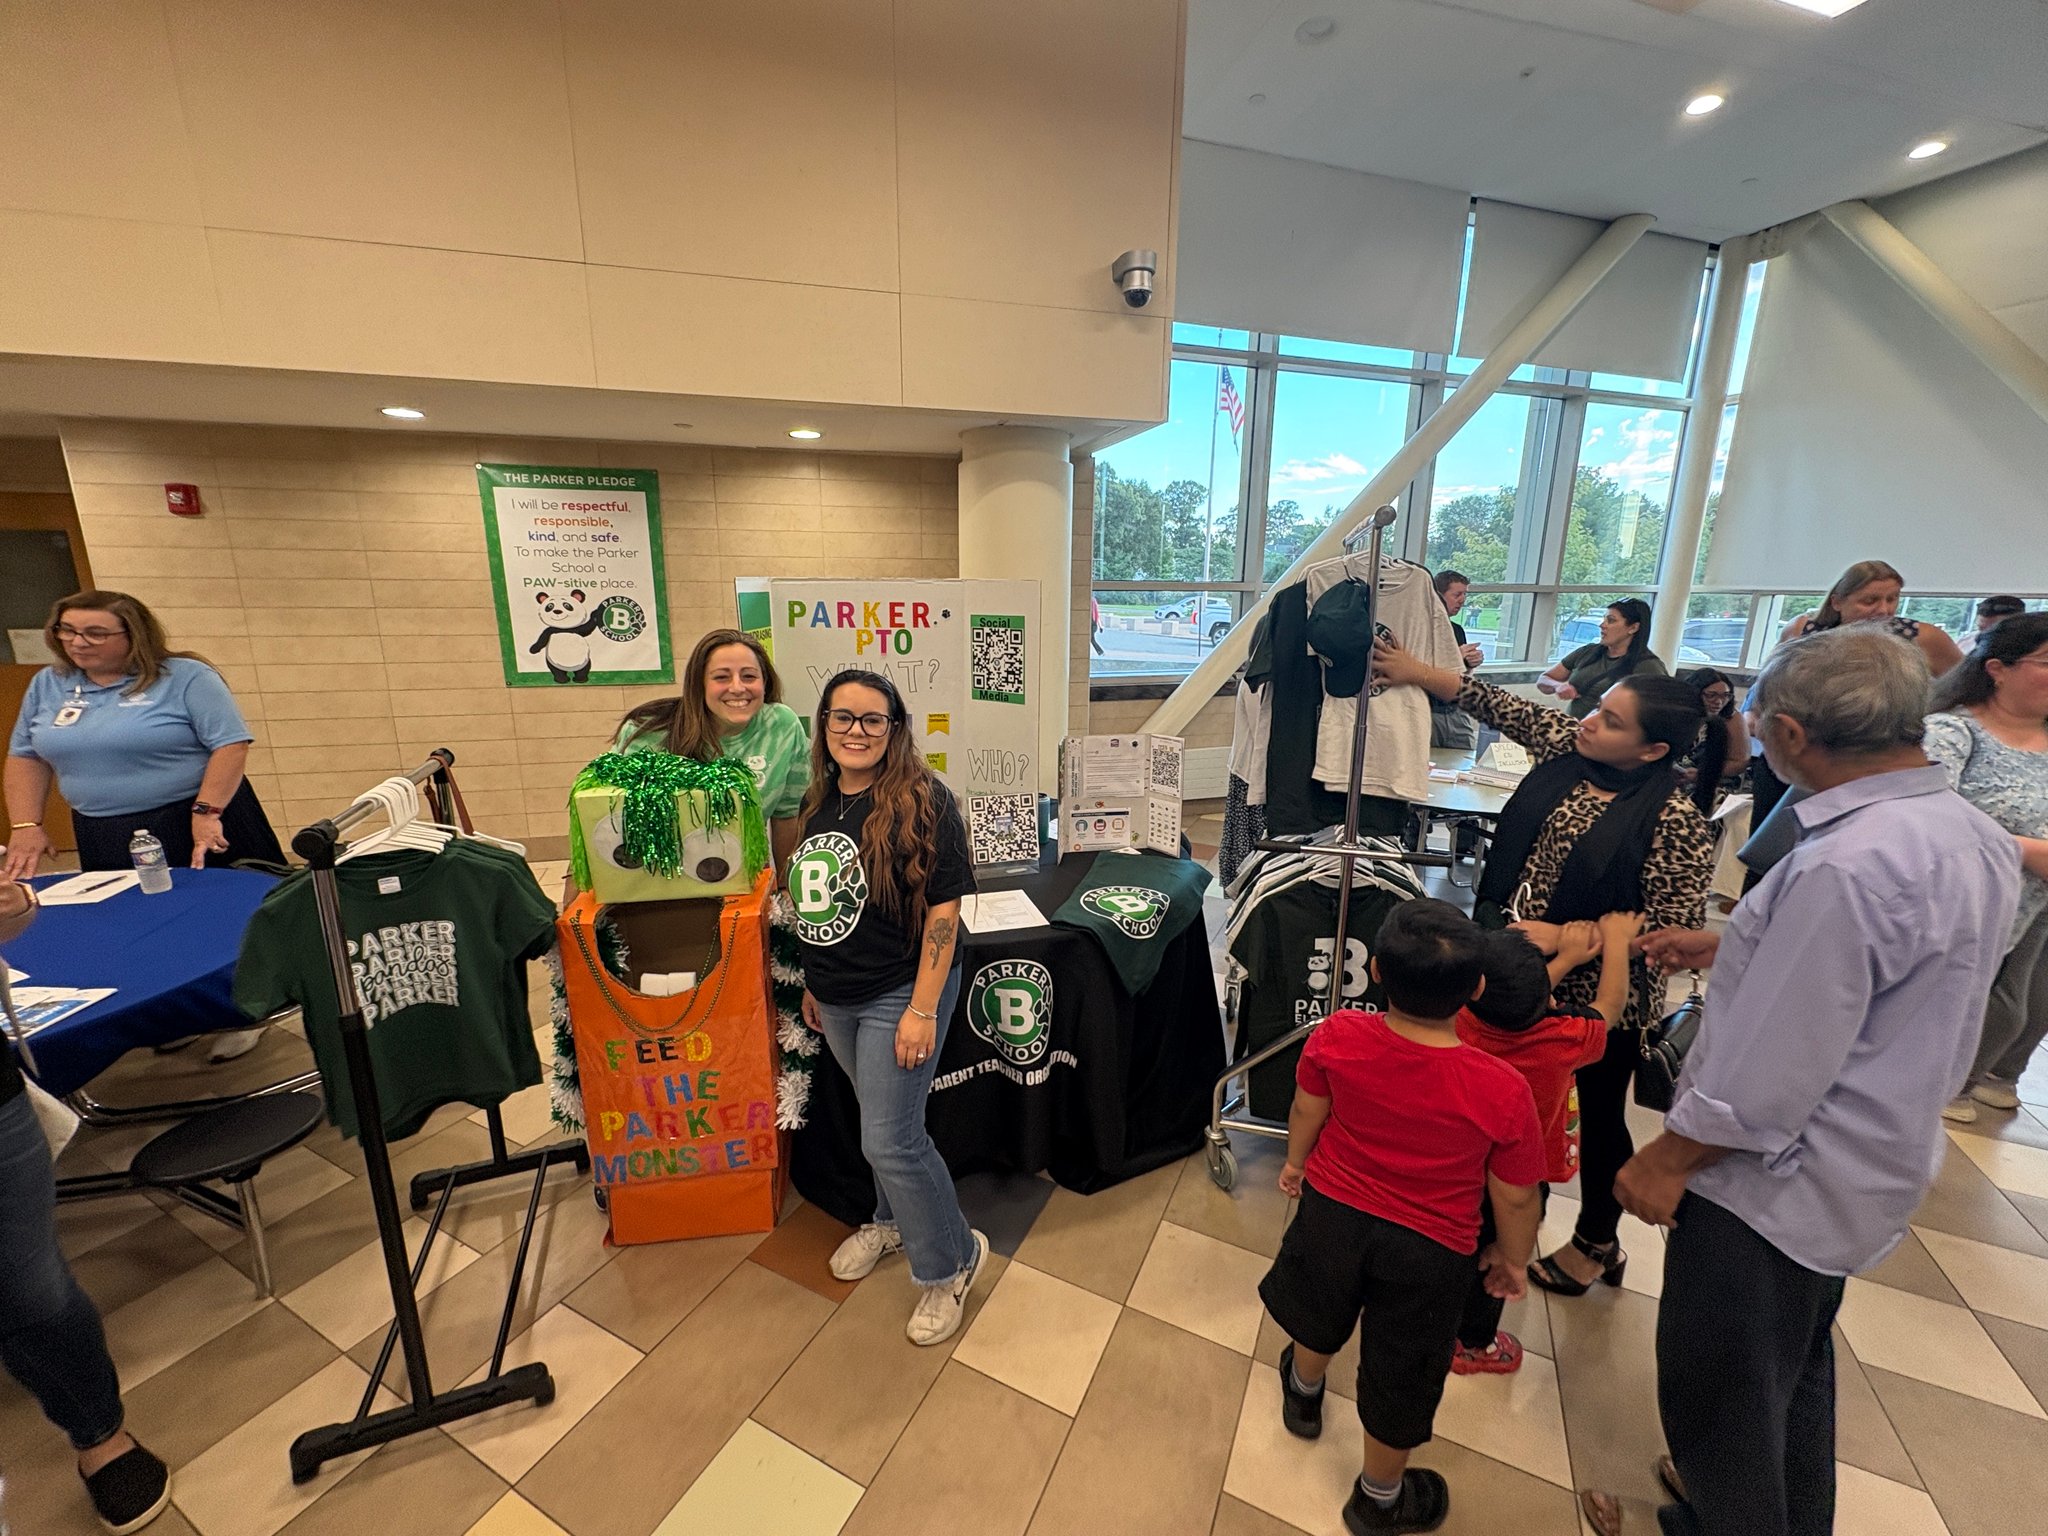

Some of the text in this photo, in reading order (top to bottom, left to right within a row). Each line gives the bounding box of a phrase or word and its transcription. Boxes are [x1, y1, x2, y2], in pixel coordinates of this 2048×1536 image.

[504, 473, 636, 487] THE PARKER PLEDGE
[511, 498, 515, 509] I
[520, 499, 538, 510] will
[542, 499, 559, 510] be
[534, 516, 613, 530] responsible,
[562, 532, 587, 543] and
[591, 532, 622, 544] safe.
[514, 547, 639, 559] To make the Parker
[552, 562, 607, 574] School a
[523, 577, 637, 591] PAW-sitive place.
[602, 596, 641, 612] PARKER
[610, 607, 630, 630] B
[979, 617, 1011, 628] Social
[600, 626, 639, 641] SCHOOL
[856, 628, 913, 656] PTO
[979, 690, 1009, 702] Media
[966, 748, 1030, 787] WHO?
[792, 835, 855, 864] PARKER
[798, 860, 831, 913] B
[1084, 886, 1142, 903] PARKER
[1102, 895, 1148, 913] B
[797, 913, 855, 941] CHOOL
[1111, 912, 1162, 935] SCHOOL
[360, 946, 450, 1002] pandas
[975, 964, 1049, 989] PARKER
[1314, 937, 1369, 999] B
[994, 987, 1035, 1035] B
[604, 1031, 713, 1072] FEED
[636, 1070, 721, 1108] THE
[928, 1065, 976, 1094] PARENT
[599, 1101, 771, 1142] PARKER
[592, 1133, 775, 1185] MONSTER
